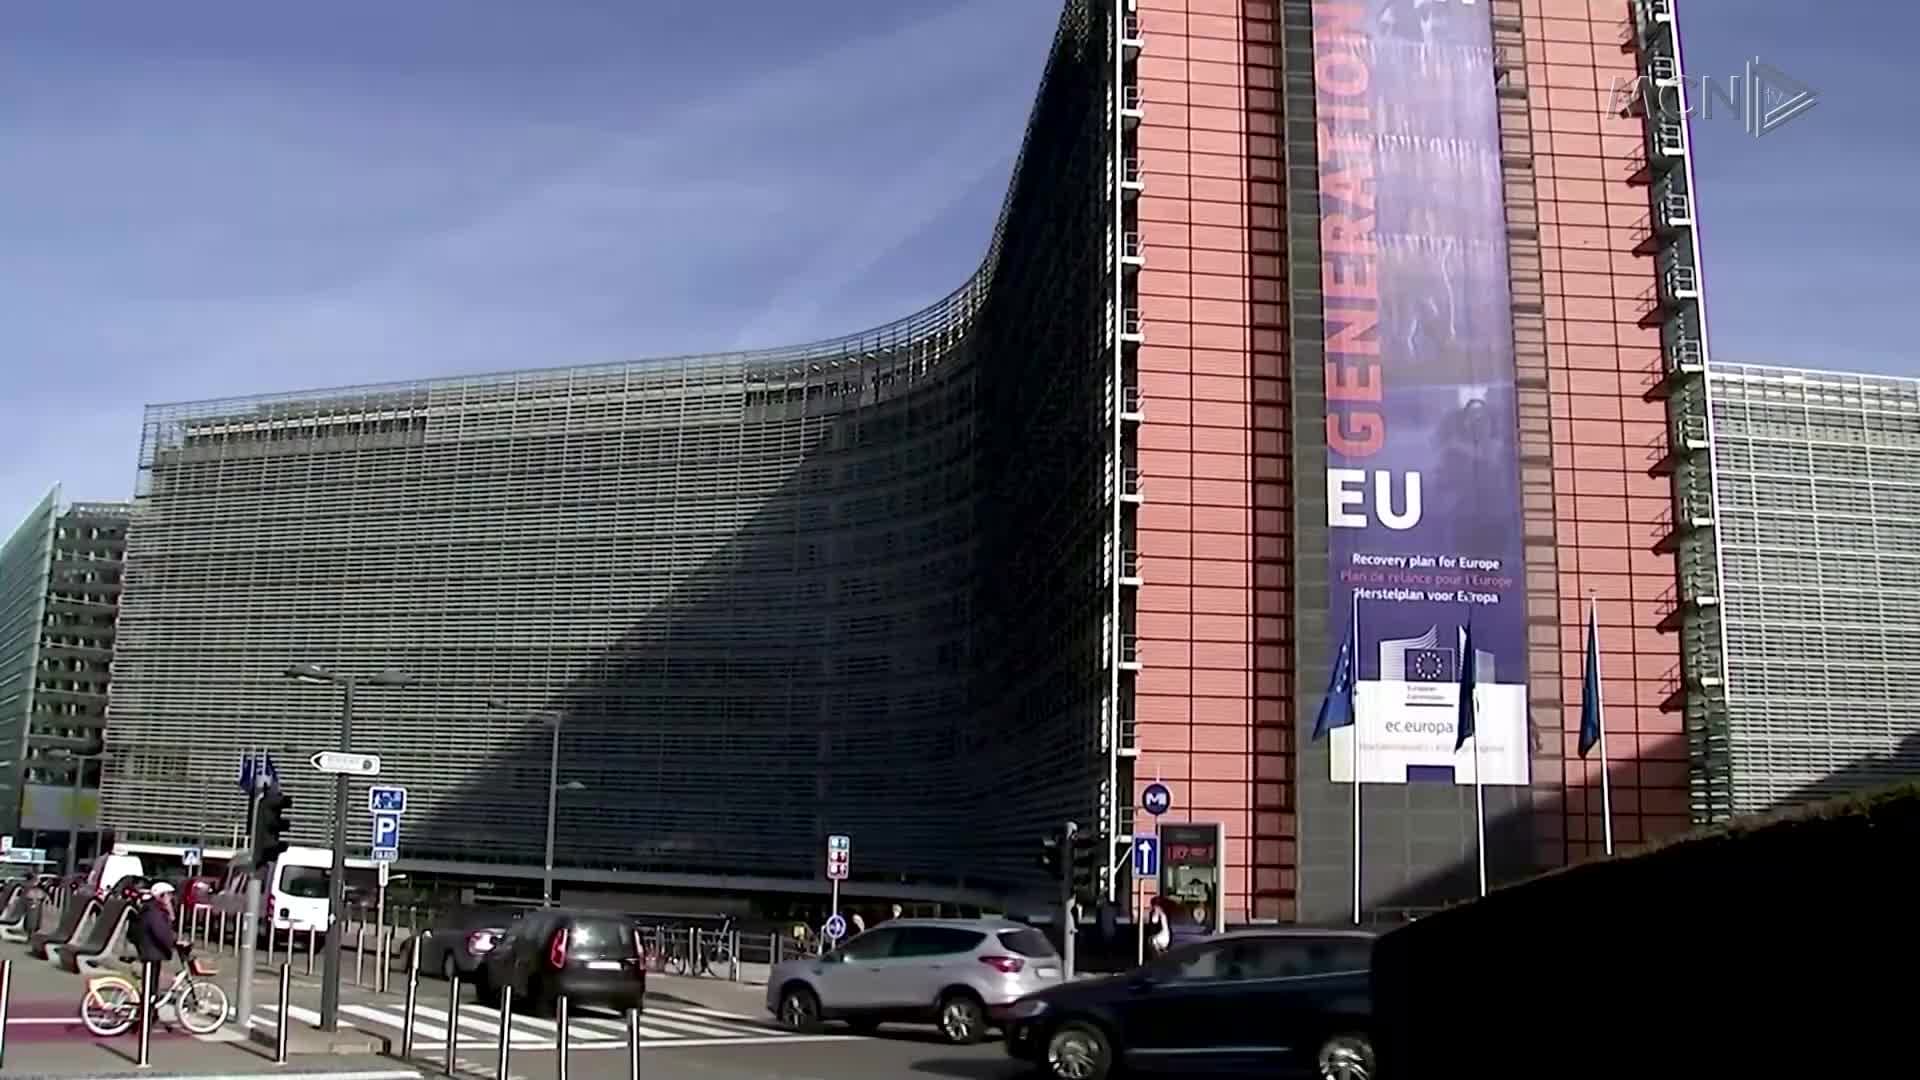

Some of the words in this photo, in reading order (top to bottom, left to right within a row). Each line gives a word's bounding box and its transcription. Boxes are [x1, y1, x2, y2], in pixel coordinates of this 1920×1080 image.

[1312, 2, 1384, 457] GENERATION
[1327, 467, 1422, 530] EU
[1352, 553, 1407, 568] Recovery
[1409, 555, 1436, 569] plan
[1439, 556, 1457, 568] for
[1459, 557, 1500, 571] Europe
[1355, 588, 1424, 601] Herstelplan
[1427, 591, 1454, 602] voor
[1146, 792, 1167, 806] M
[377, 817, 396, 844] P
